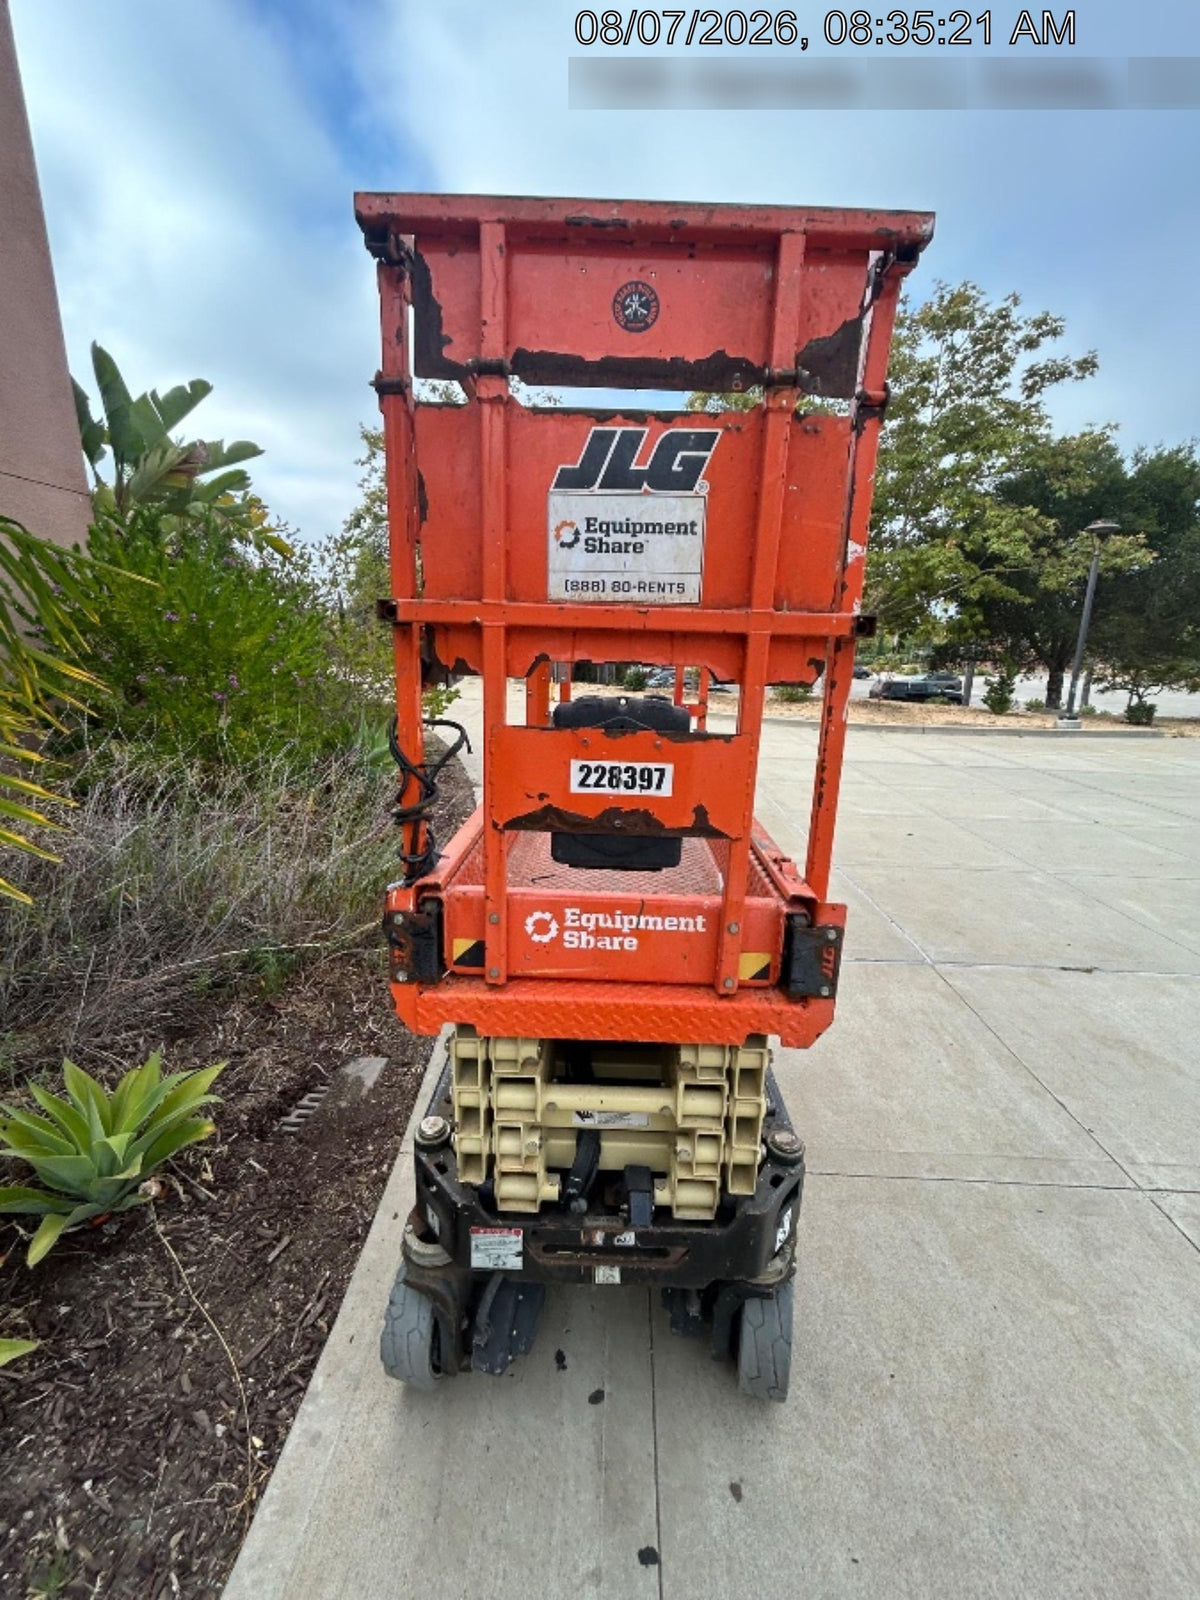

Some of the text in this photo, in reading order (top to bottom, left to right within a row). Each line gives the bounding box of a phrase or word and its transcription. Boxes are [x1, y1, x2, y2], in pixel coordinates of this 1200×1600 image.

[549, 426, 723, 494] JLG
[584, 516, 698, 538] Equipment
[584, 537, 645, 554] Share
[564, 578, 686, 594] (888) 80-RENTS
[577, 763, 667, 792] 228397
[563, 907, 707, 933] Equipment
[563, 925, 639, 951] Share
